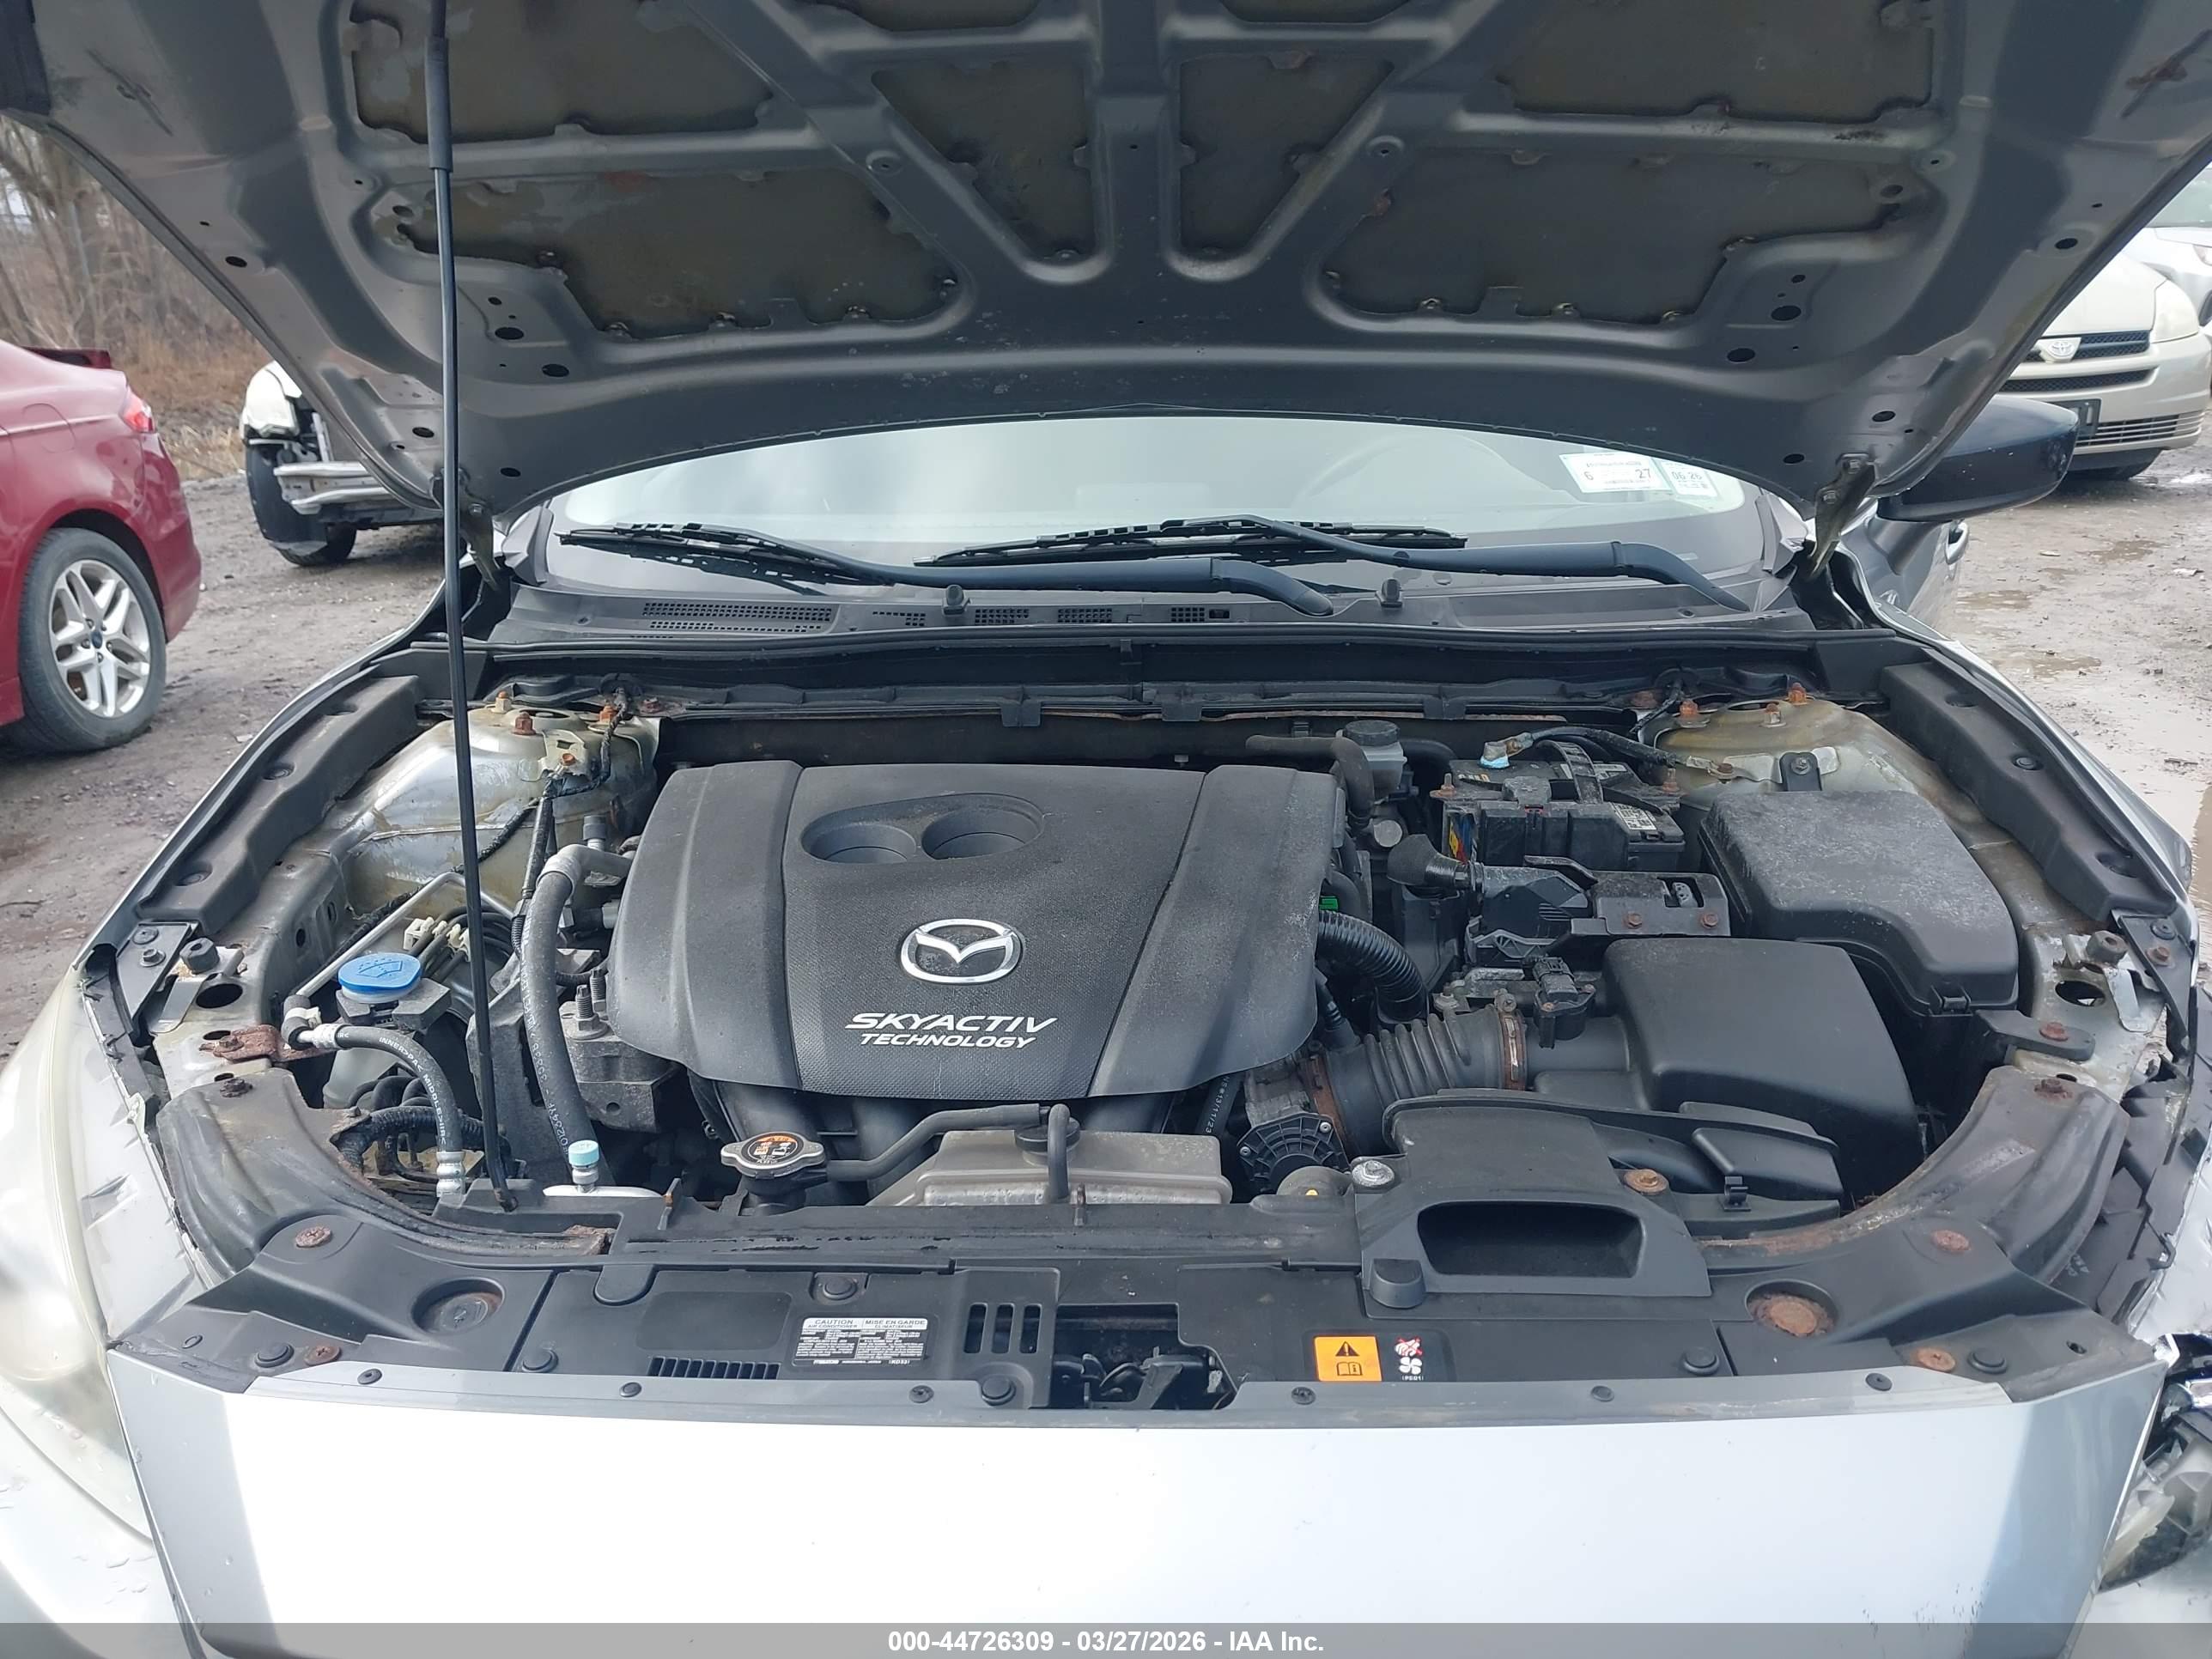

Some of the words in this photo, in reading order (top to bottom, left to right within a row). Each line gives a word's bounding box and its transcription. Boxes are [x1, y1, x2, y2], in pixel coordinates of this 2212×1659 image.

[1634, 469, 1651, 479] 27
[845, 1012, 1058, 1033] SKYACTIV
[860, 1033, 1036, 1048] TECHNOLOGY
